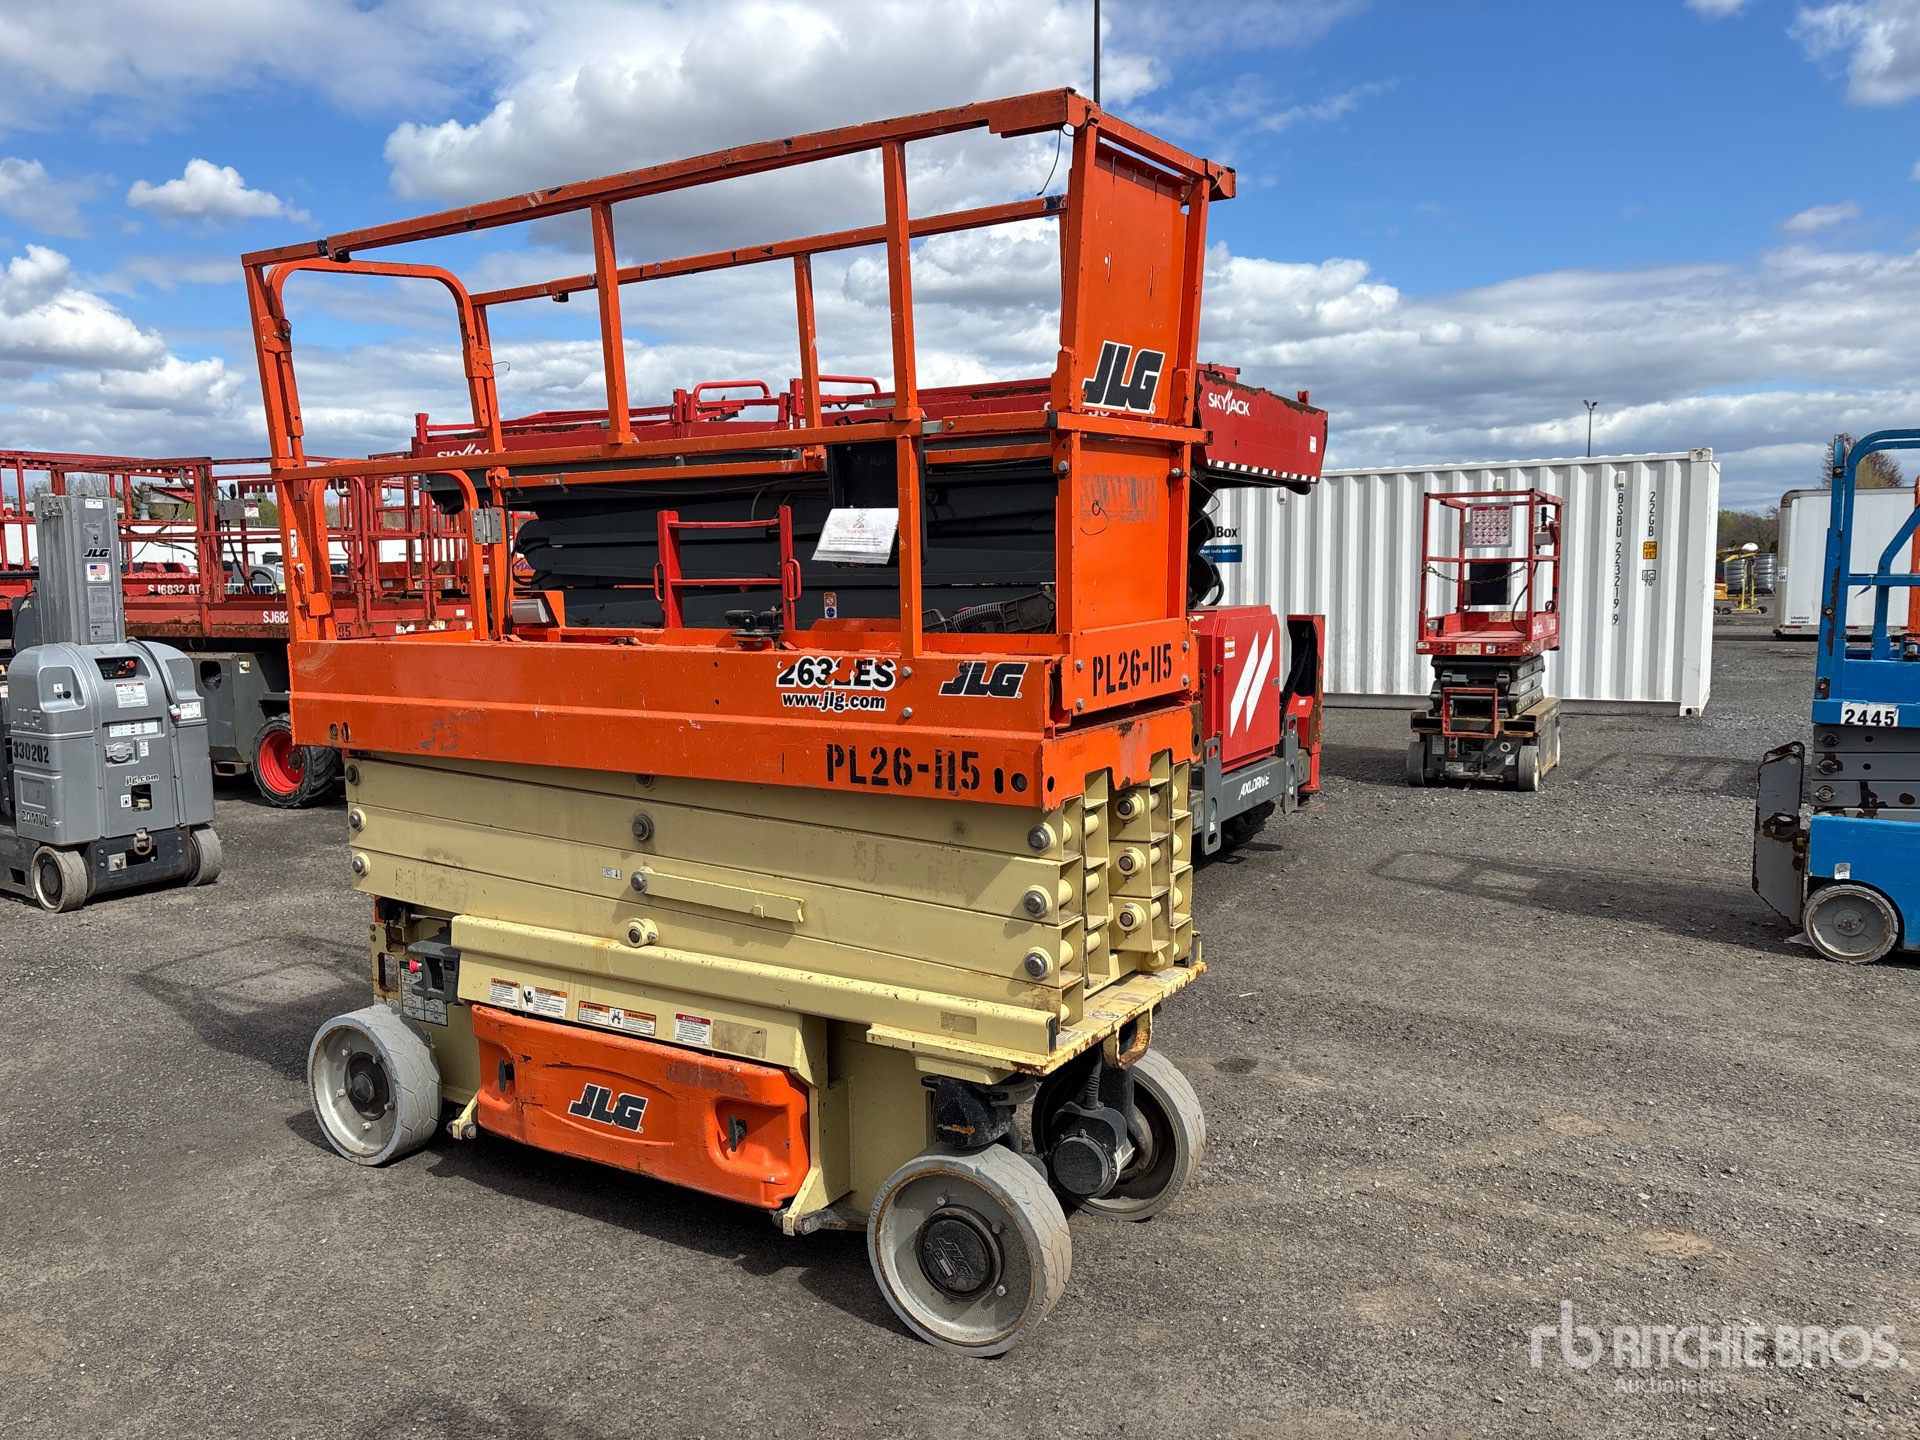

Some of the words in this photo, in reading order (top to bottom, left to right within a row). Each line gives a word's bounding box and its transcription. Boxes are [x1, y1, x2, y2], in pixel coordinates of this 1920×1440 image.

[1082, 340, 1166, 414] JLG
[1208, 388, 1250, 416] SKYJACK
[1616, 493, 1624, 538] BSBU
[1648, 491, 1656, 537] 22GB
[83, 548, 110, 558] JLG
[1613, 542, 1622, 608] 223219
[262, 610, 289, 624] SJ682
[1612, 613, 1620, 625] 9
[938, 661, 1029, 698] JLG
[1093, 643, 1172, 697] PL26-115
[782, 691, 886, 713] www.jlg.com
[1844, 708, 1895, 727] 2445
[13, 741, 50, 764] 330202
[826, 743, 980, 791] PL26-115
[125, 774, 160, 786] jlg.com
[567, 1083, 650, 1134] JLG
